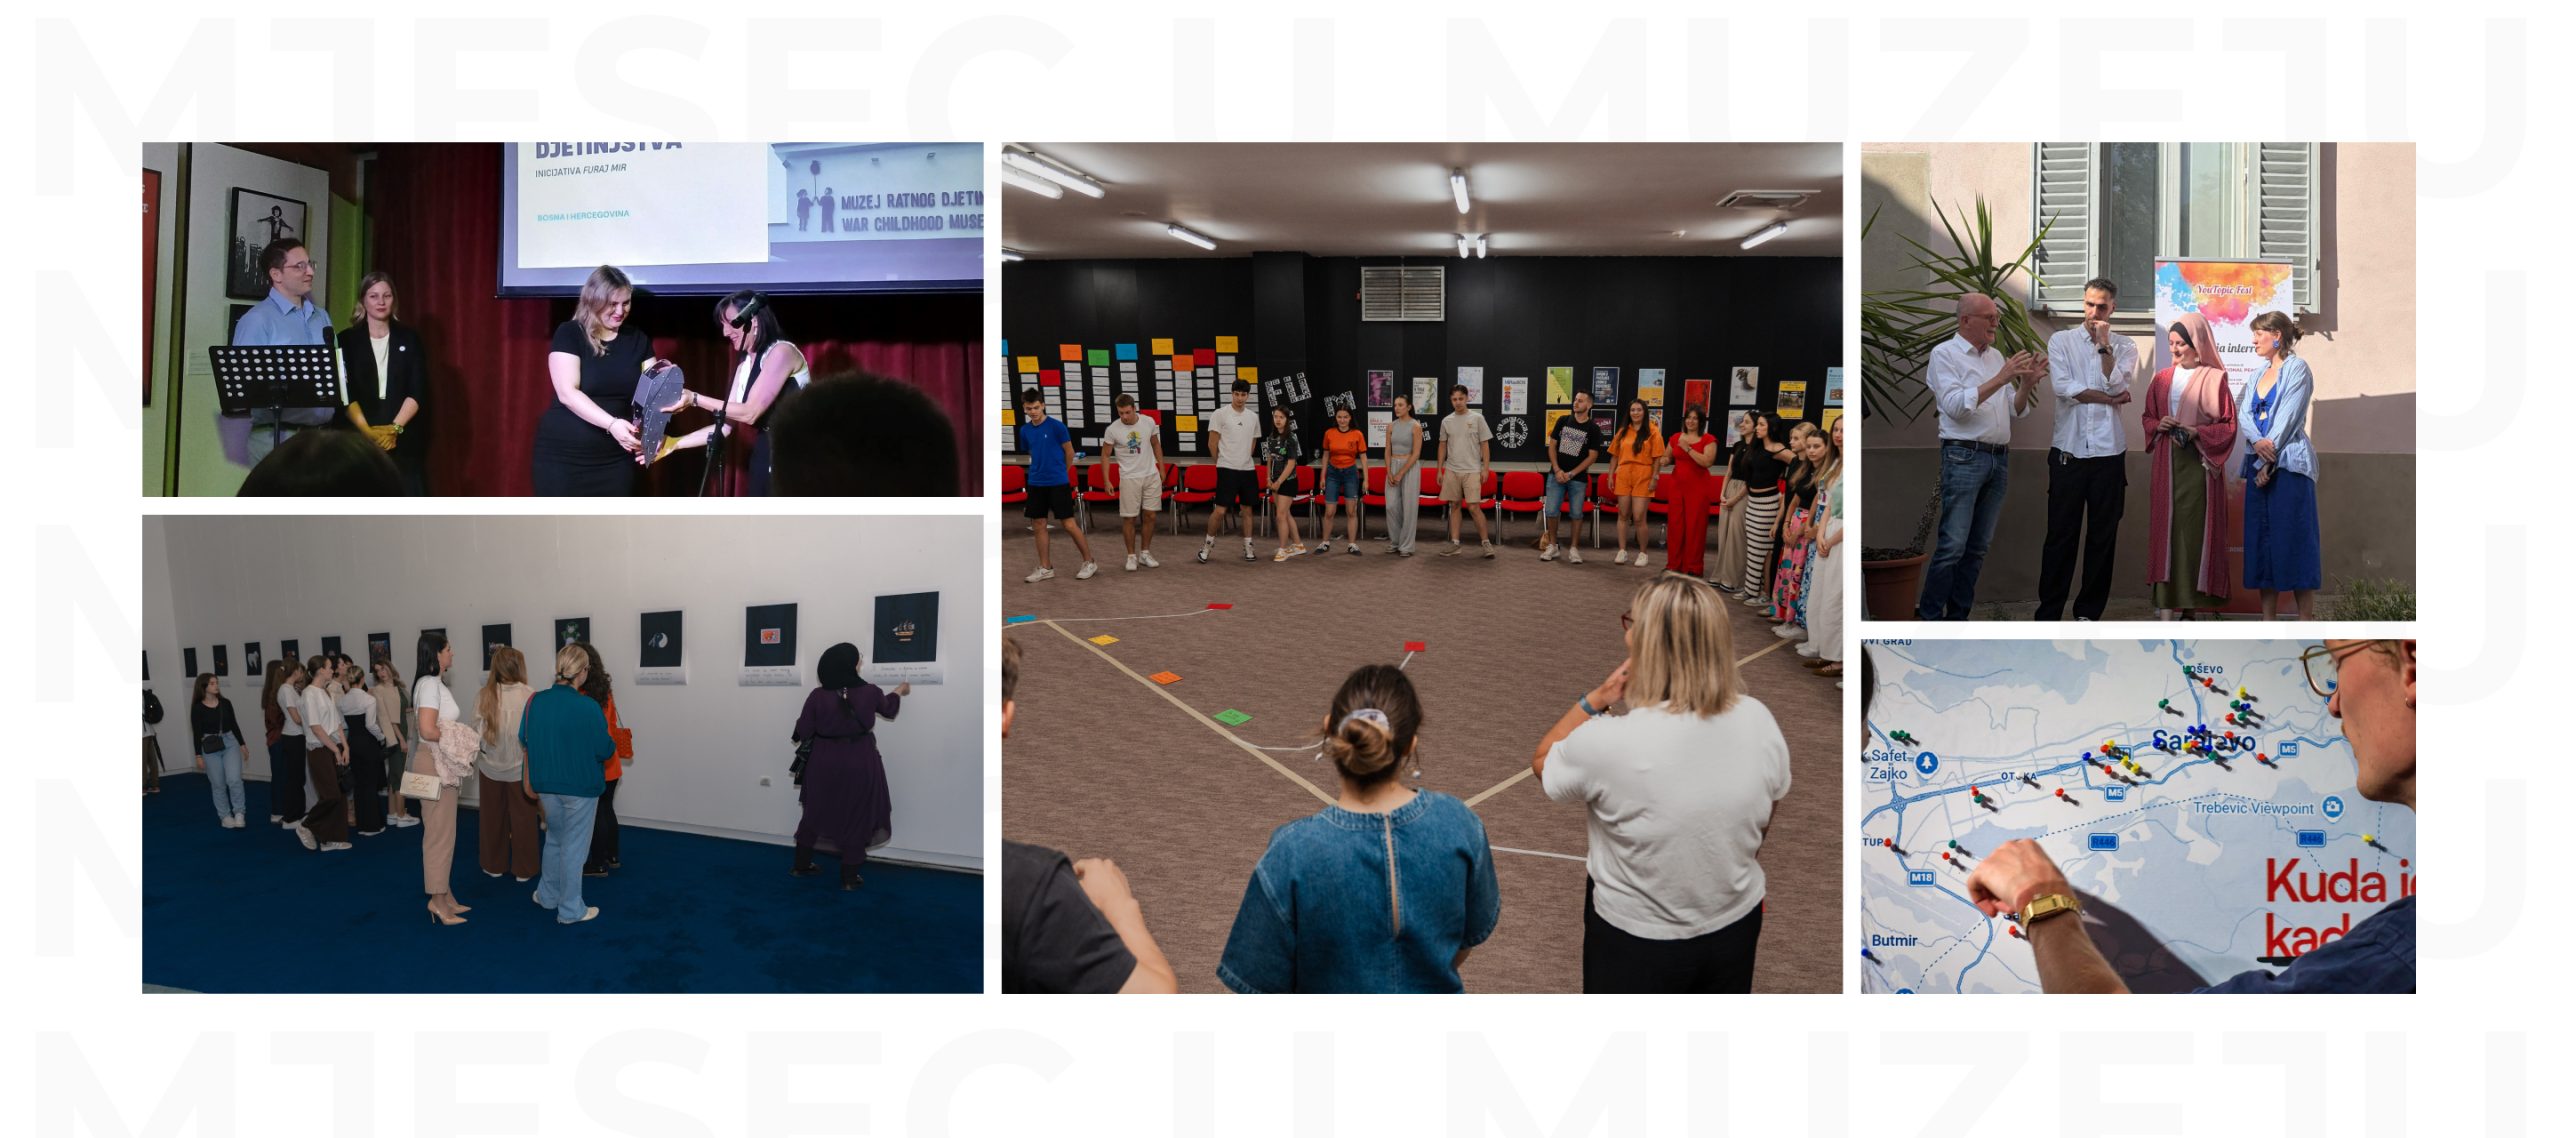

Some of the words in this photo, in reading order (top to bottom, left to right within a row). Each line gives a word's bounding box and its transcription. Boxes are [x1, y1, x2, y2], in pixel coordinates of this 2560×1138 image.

[535, 166, 581, 178] INICIJATIVA
[582, 164, 609, 175] FURAJ
[610, 163, 628, 172] MIR
[841, 194, 881, 211] MUZEJ
[887, 192, 936, 209] RATNOG
[537, 213, 565, 222] BOSNA
[570, 209, 630, 220] HERCEGOVINA
[842, 217, 869, 232] WAR
[874, 215, 943, 232] CHILDHOOD
[949, 213, 984, 230] MUSE
[2198, 284, 2233, 296] YouTopic
[2237, 285, 2252, 294] Fest
[2183, 663, 2224, 674] OŠEVO
[1871, 748, 1908, 762] Safet
[2281, 745, 2296, 753] M5
[1870, 766, 1908, 782] Zajko
[2001, 771, 2038, 781] OTKA
[2108, 788, 2123, 797] M5
[2194, 801, 2248, 814] Trebevic
[2251, 802, 2314, 816] Viewpoint
[1911, 873, 1932, 882] M18
[2266, 858, 2387, 903] Kuda
[1872, 934, 1919, 947] Butmir
